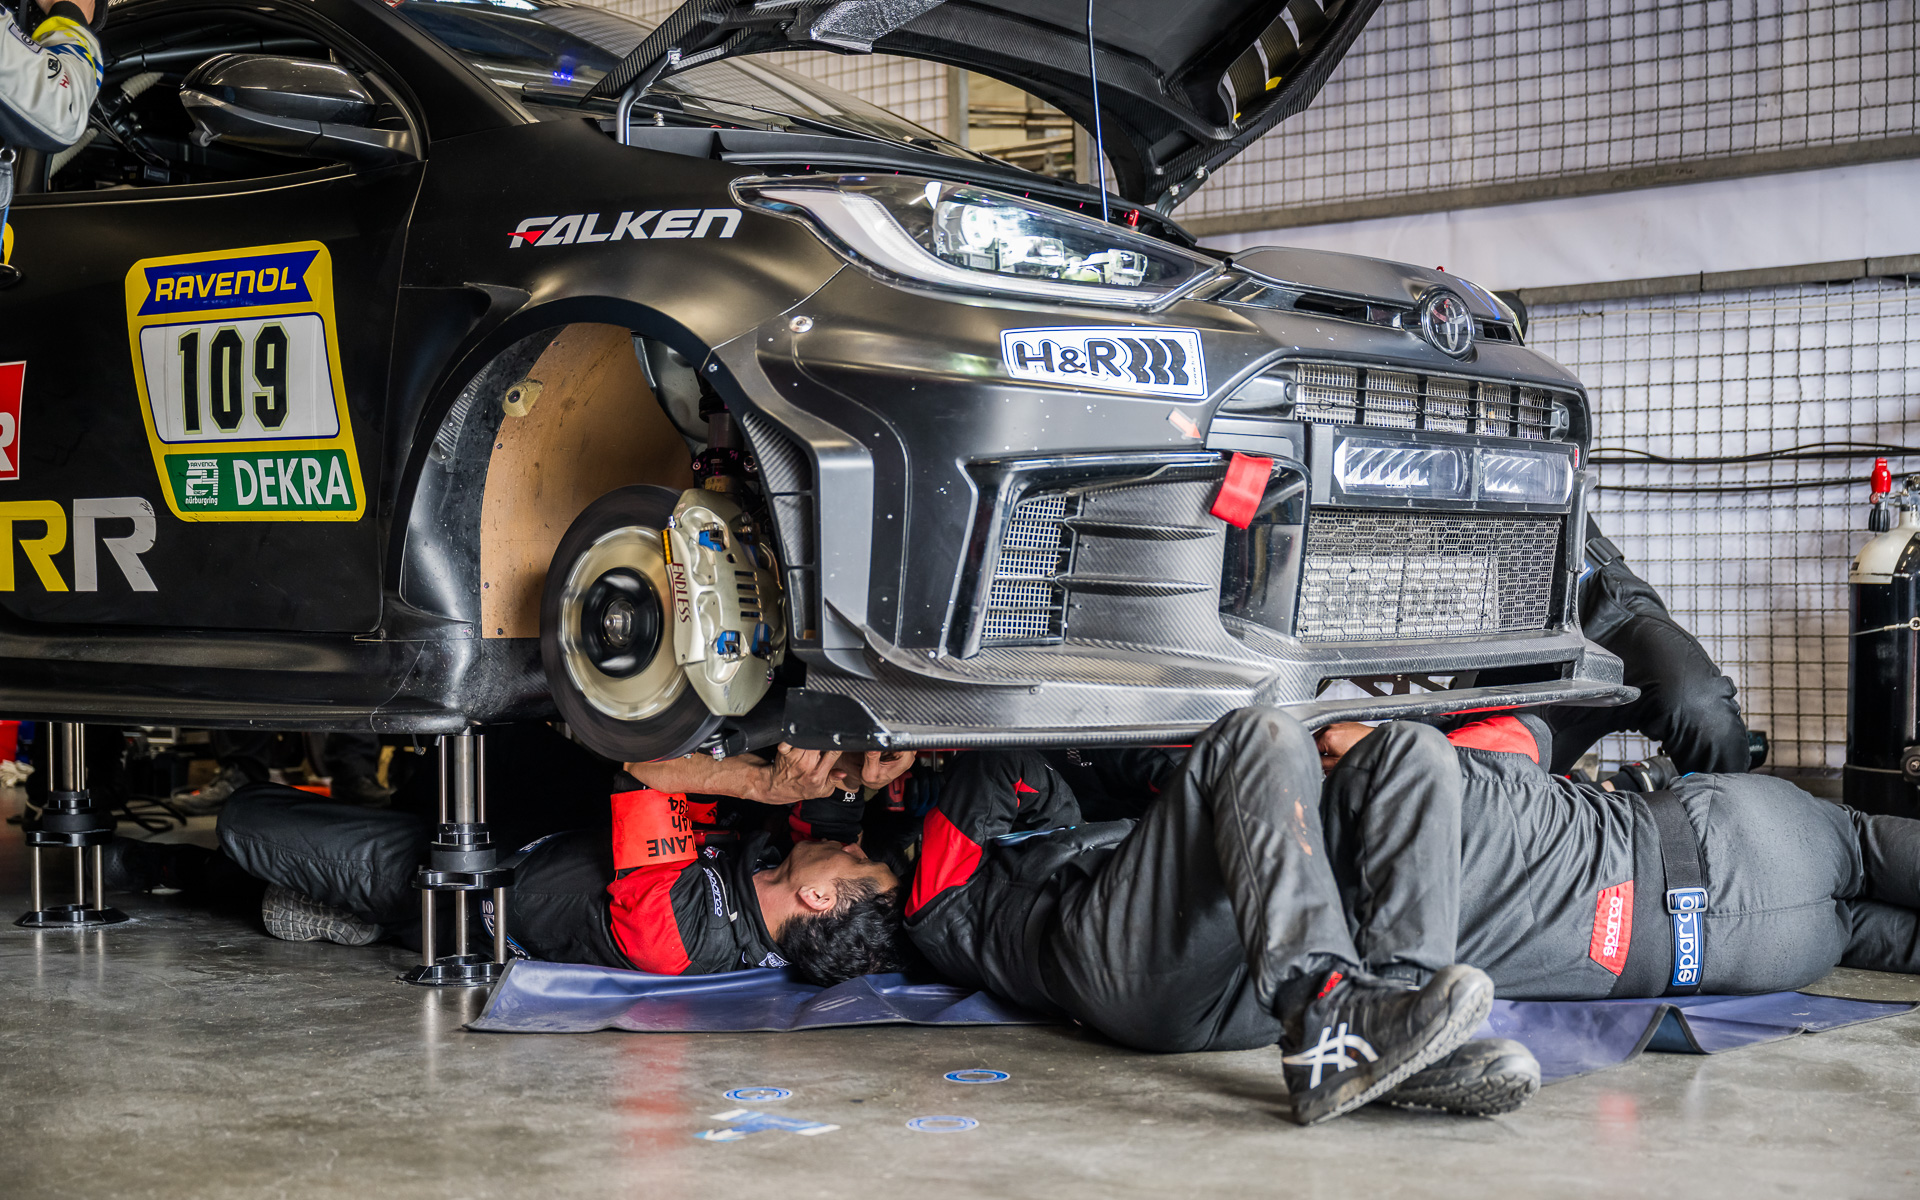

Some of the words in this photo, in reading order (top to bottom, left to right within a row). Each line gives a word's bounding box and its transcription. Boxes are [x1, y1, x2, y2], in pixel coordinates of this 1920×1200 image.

[507, 208, 743, 249] FALKEN
[155, 266, 297, 302] RAVENOL
[178, 321, 290, 435] 109
[1013, 338, 1123, 379] H&R
[232, 456, 351, 505] DEKRA
[672, 562, 692, 623] ENDLESS
[646, 834, 697, 858] LANE
[1603, 896, 1624, 958] sparco
